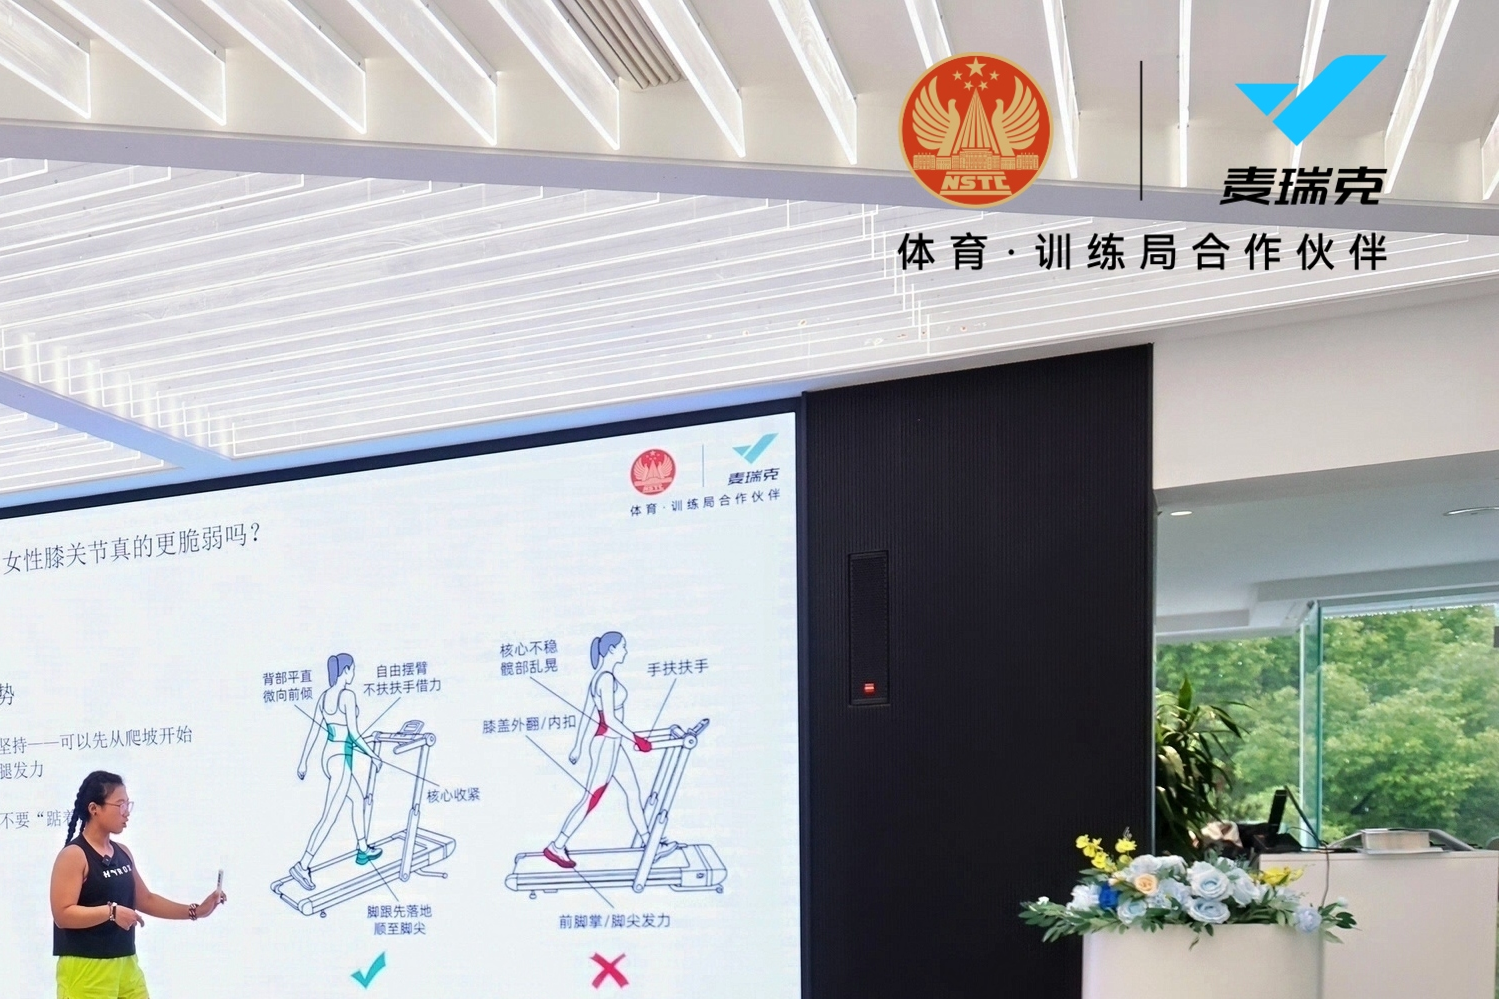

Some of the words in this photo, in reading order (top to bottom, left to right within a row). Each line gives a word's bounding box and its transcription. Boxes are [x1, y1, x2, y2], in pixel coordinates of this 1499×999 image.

[727, 467, 780, 486] 麦瑞克
[630, 488, 781, 516] 体育·训练局合作伙伴
[499, 639, 558, 658] 核心不稳
[376, 661, 429, 679] 自由摆臂
[646, 658, 709, 678] 手扶扶手
[262, 669, 313, 686] 背部平直
[262, 687, 314, 704] 微向前倾
[363, 678, 443, 697] 不扶扶手借力
[482, 714, 577, 735] 膝盖外翻/内扣
[427, 787, 481, 804] 核心收紧
[367, 904, 433, 919] 脚跟先落地
[373, 921, 427, 937] 顺至脚尖
[559, 913, 672, 930] 前脚掌/脚尖发力
